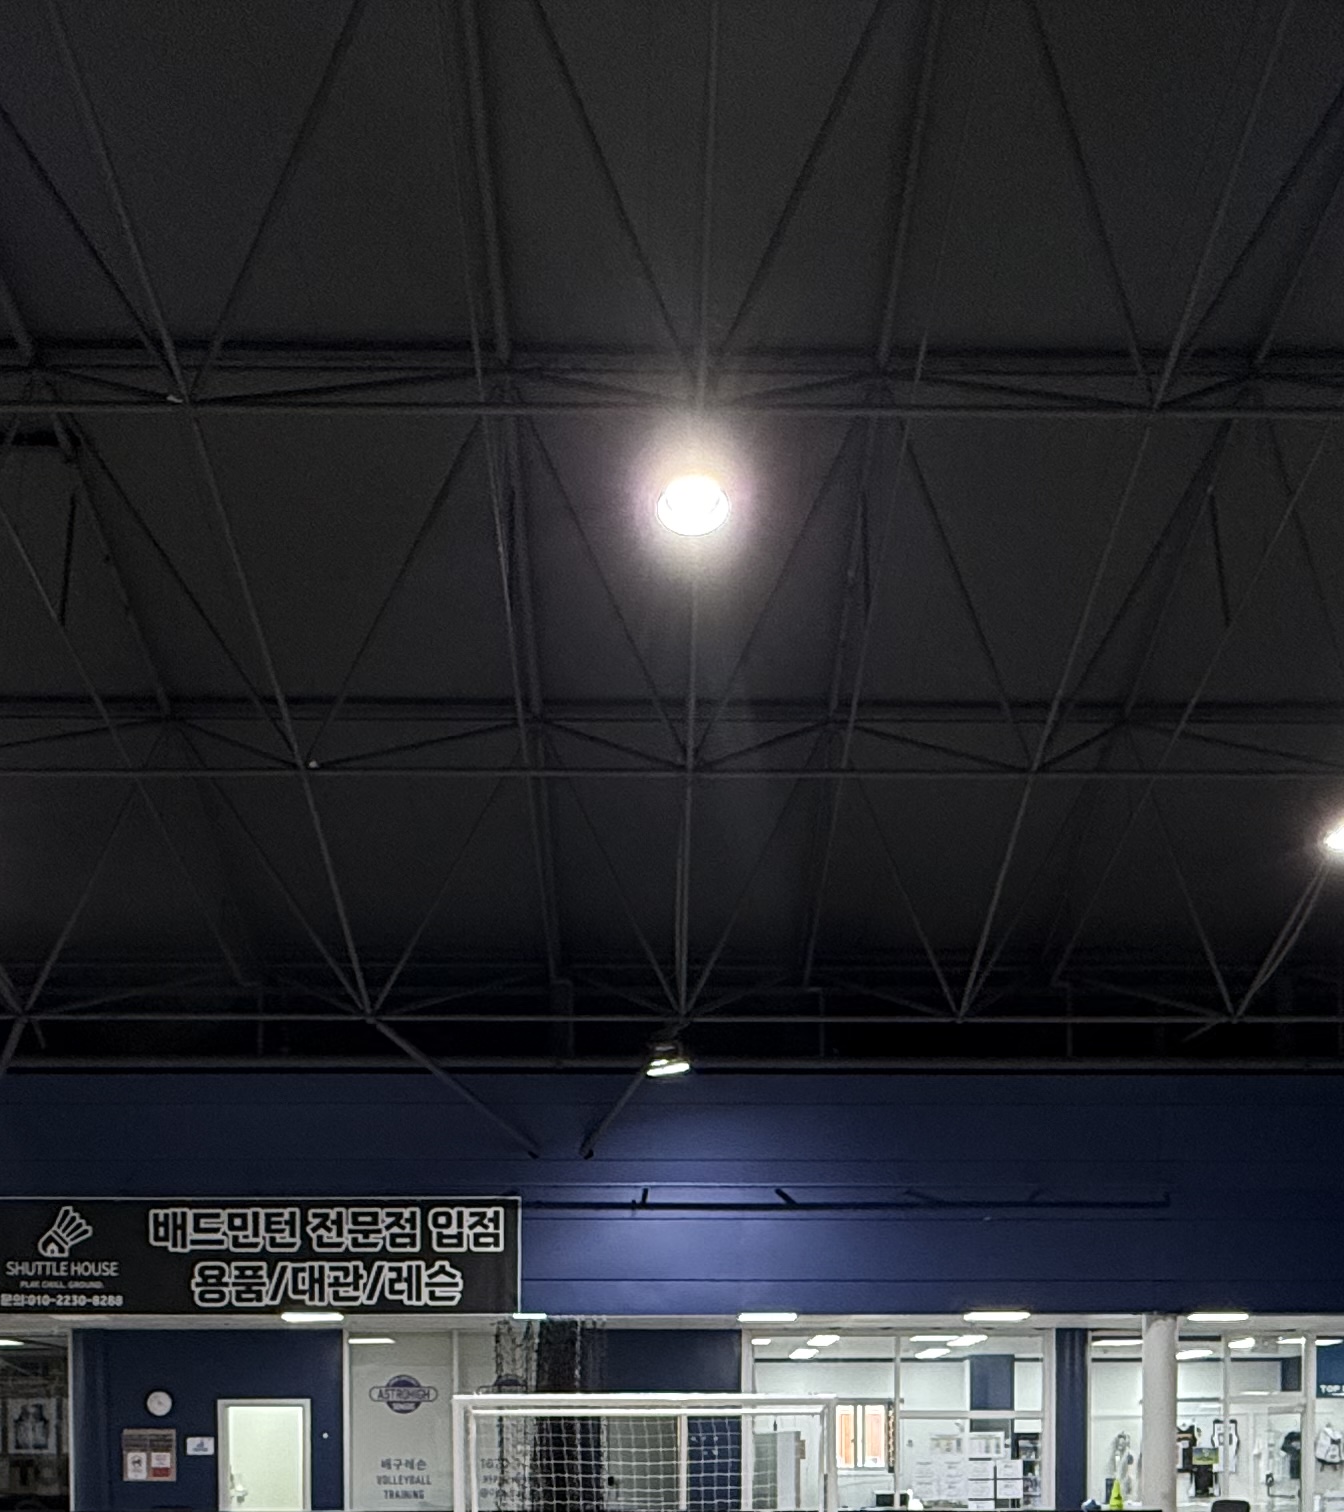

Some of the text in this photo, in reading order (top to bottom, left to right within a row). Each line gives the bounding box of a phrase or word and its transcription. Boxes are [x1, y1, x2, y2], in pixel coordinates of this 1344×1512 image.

[149, 1207, 505, 1252] 배드민턴 전문점 입점
[6, 1261, 120, 1277] SHUTTLE HOUSE
[191, 1261, 464, 1307] 용품/대관/레슨
[1319, 1384, 1341, 1394] TOP
[380, 1458, 428, 1471] 배구레슨
[376, 1475, 432, 1486] VOLLEYBALL
[383, 1490, 425, 1500] TRAINING
